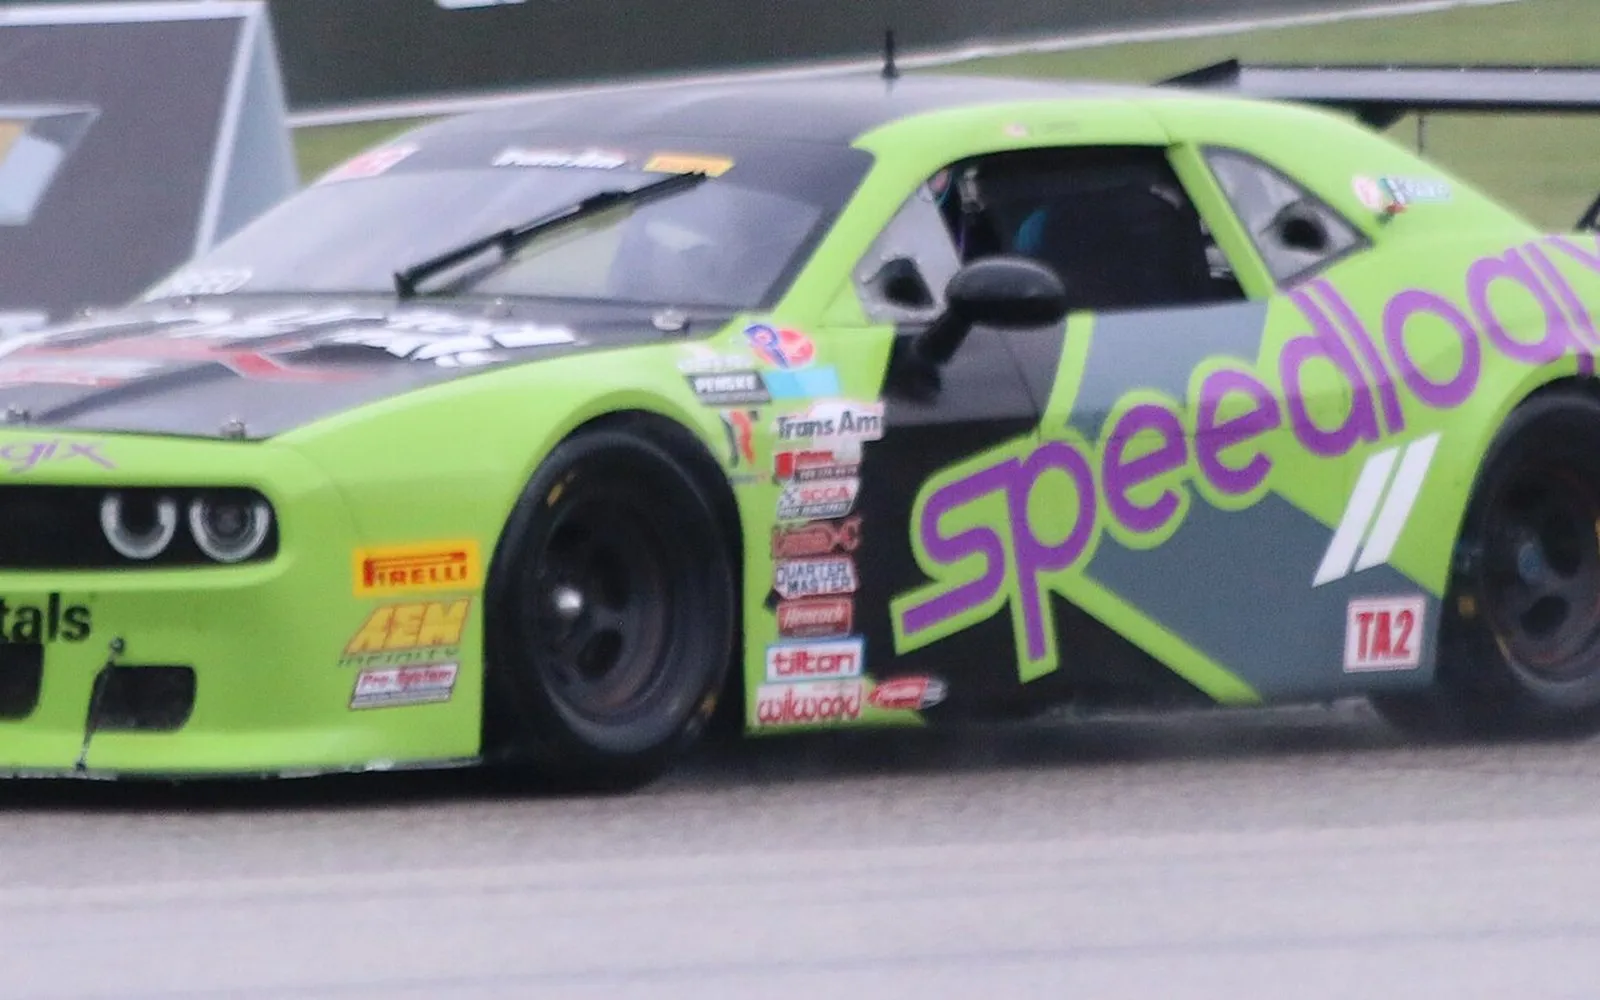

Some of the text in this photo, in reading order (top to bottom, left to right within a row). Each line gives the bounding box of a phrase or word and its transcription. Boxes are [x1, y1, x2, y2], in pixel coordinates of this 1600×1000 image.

[776, 409, 881, 440] Trans Am
[903, 232, 1600, 662] speedlogi
[363, 551, 468, 588] PIRELLI
[344, 596, 471, 658] AEM
[1356, 609, 1414, 662] TA2
[773, 650, 855, 676] tilton
[758, 687, 860, 723] wilwood
